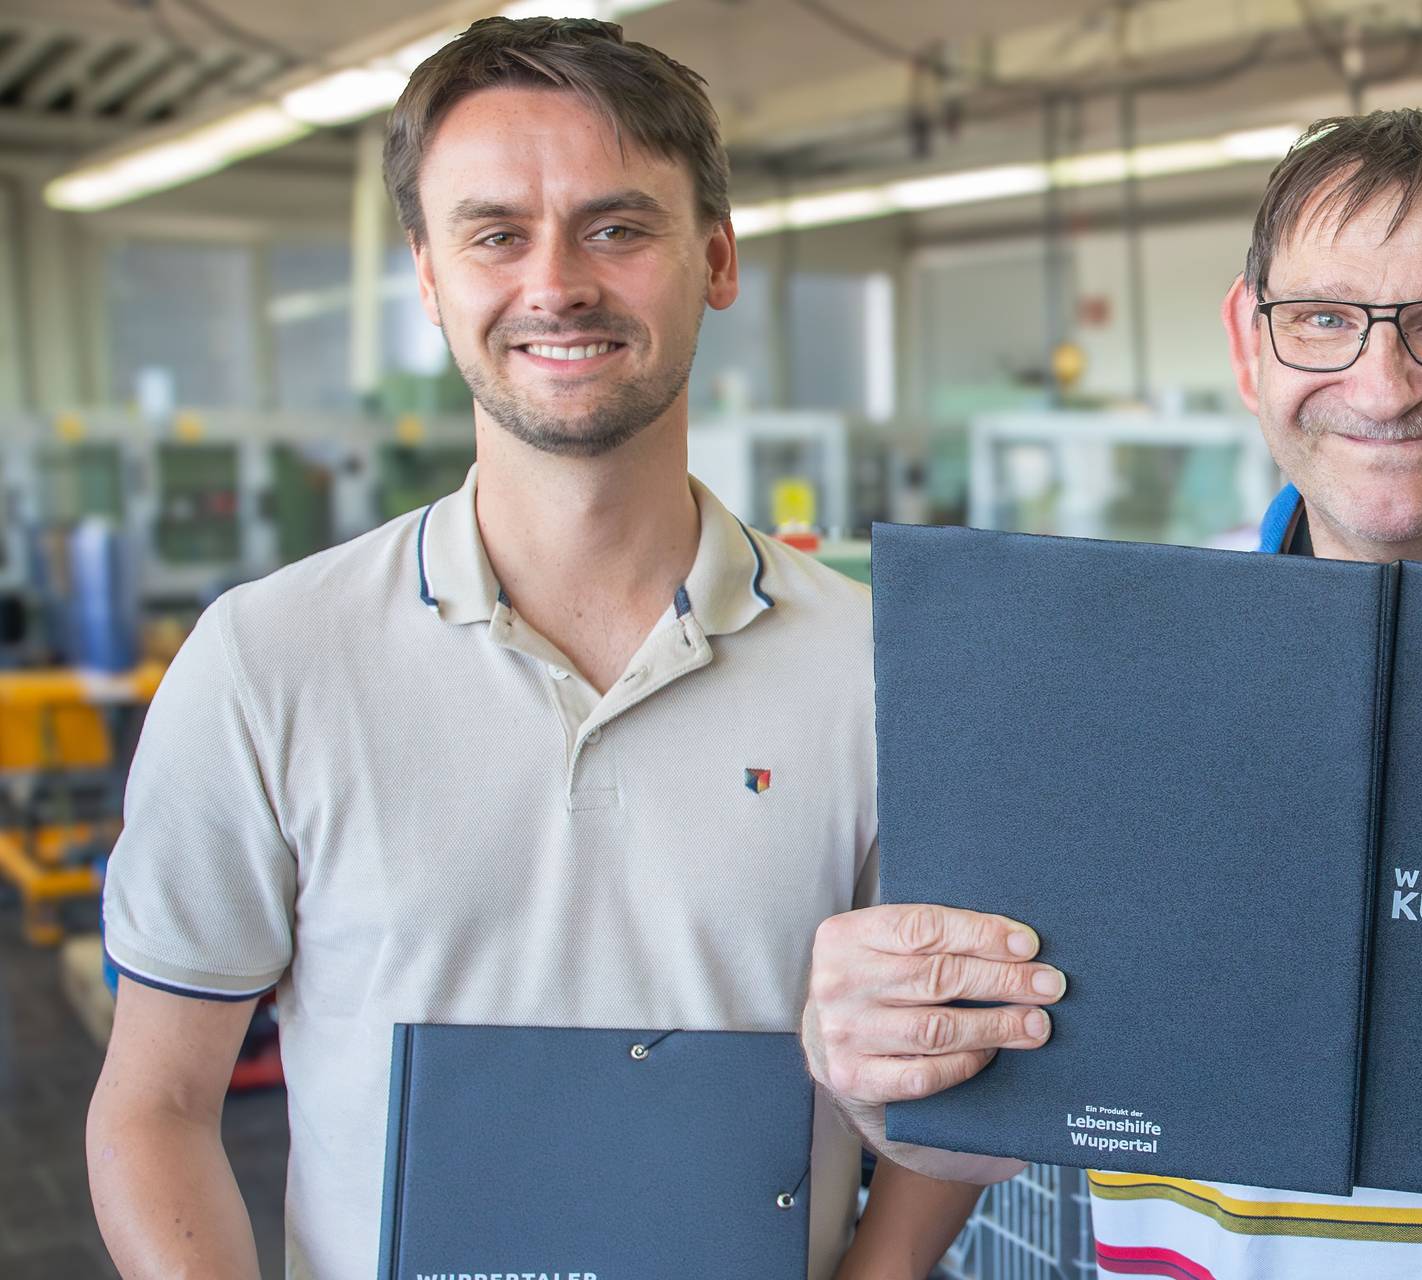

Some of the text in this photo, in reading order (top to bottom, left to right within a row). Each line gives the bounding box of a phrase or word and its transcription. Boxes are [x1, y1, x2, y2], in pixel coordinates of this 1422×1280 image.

[1085, 1105, 1144, 1118] Ein Produkt der
[1067, 1113, 1162, 1135] Lebenshilfe
[1070, 1132, 1158, 1153] Wuppertal
